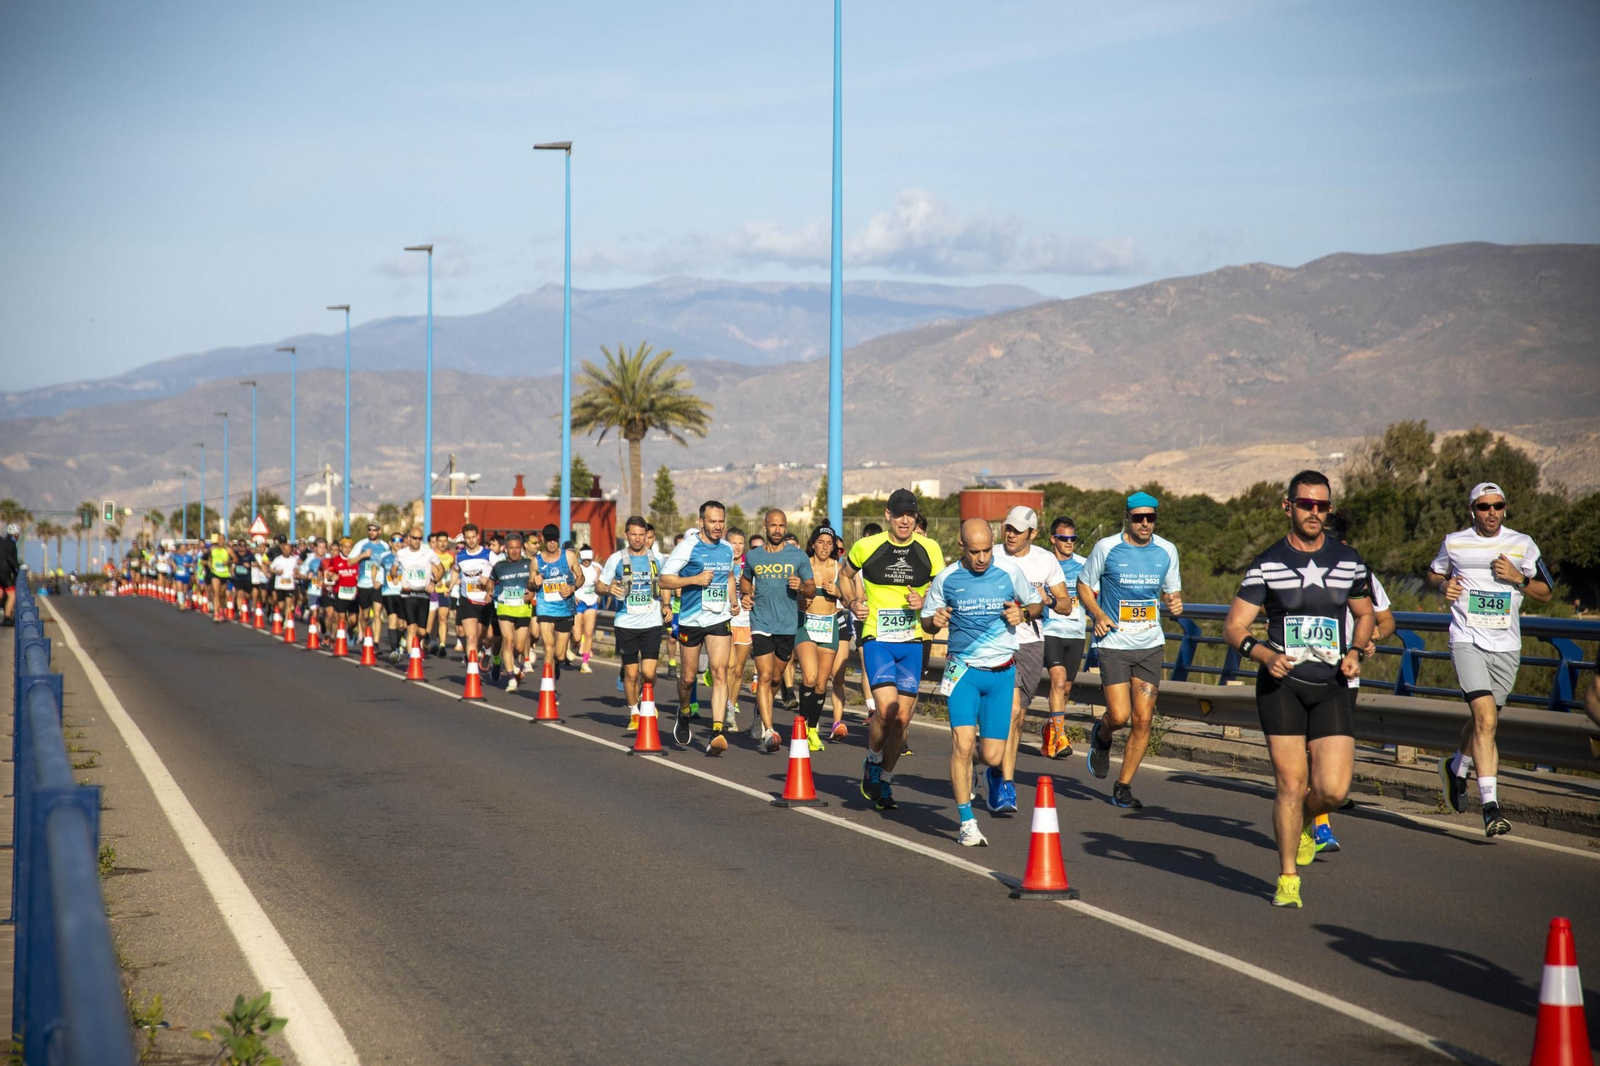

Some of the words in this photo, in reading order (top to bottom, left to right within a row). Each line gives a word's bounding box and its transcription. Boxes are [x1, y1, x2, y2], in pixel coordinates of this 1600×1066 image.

[755, 563, 794, 575] exon
[630, 595, 651, 603] 1682
[1478, 597, 1504, 610] 348
[1132, 607, 1147, 618] 95
[807, 619, 831, 630] 2075
[882, 616, 914, 627] 2497
